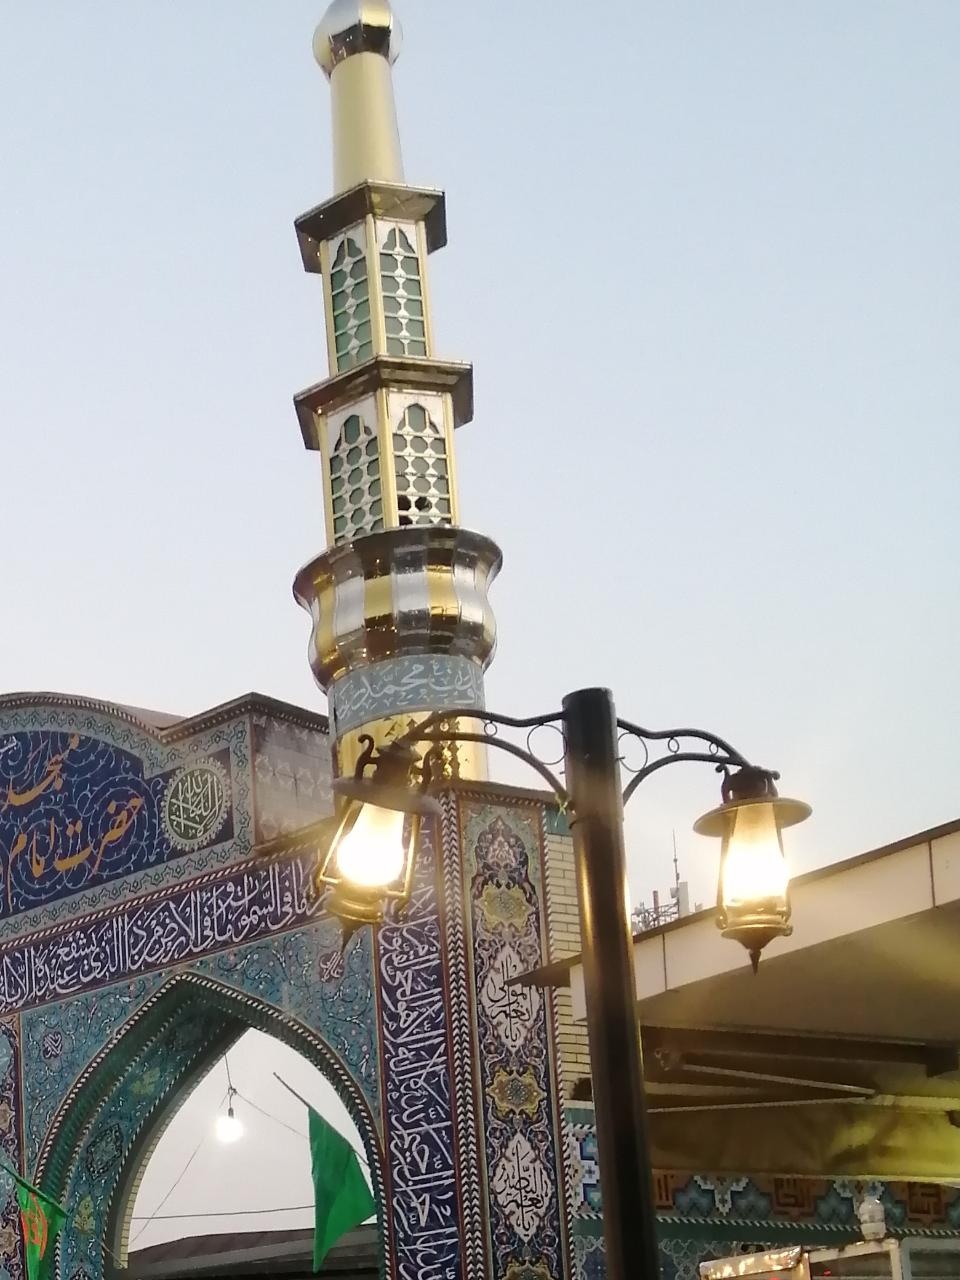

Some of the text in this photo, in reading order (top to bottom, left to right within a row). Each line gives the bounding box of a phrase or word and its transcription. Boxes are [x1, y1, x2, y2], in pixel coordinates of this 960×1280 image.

[1, 731, 81, 812] مسجد
[7, 816, 55, 912] امام
[54, 796, 144, 877] حضرت
